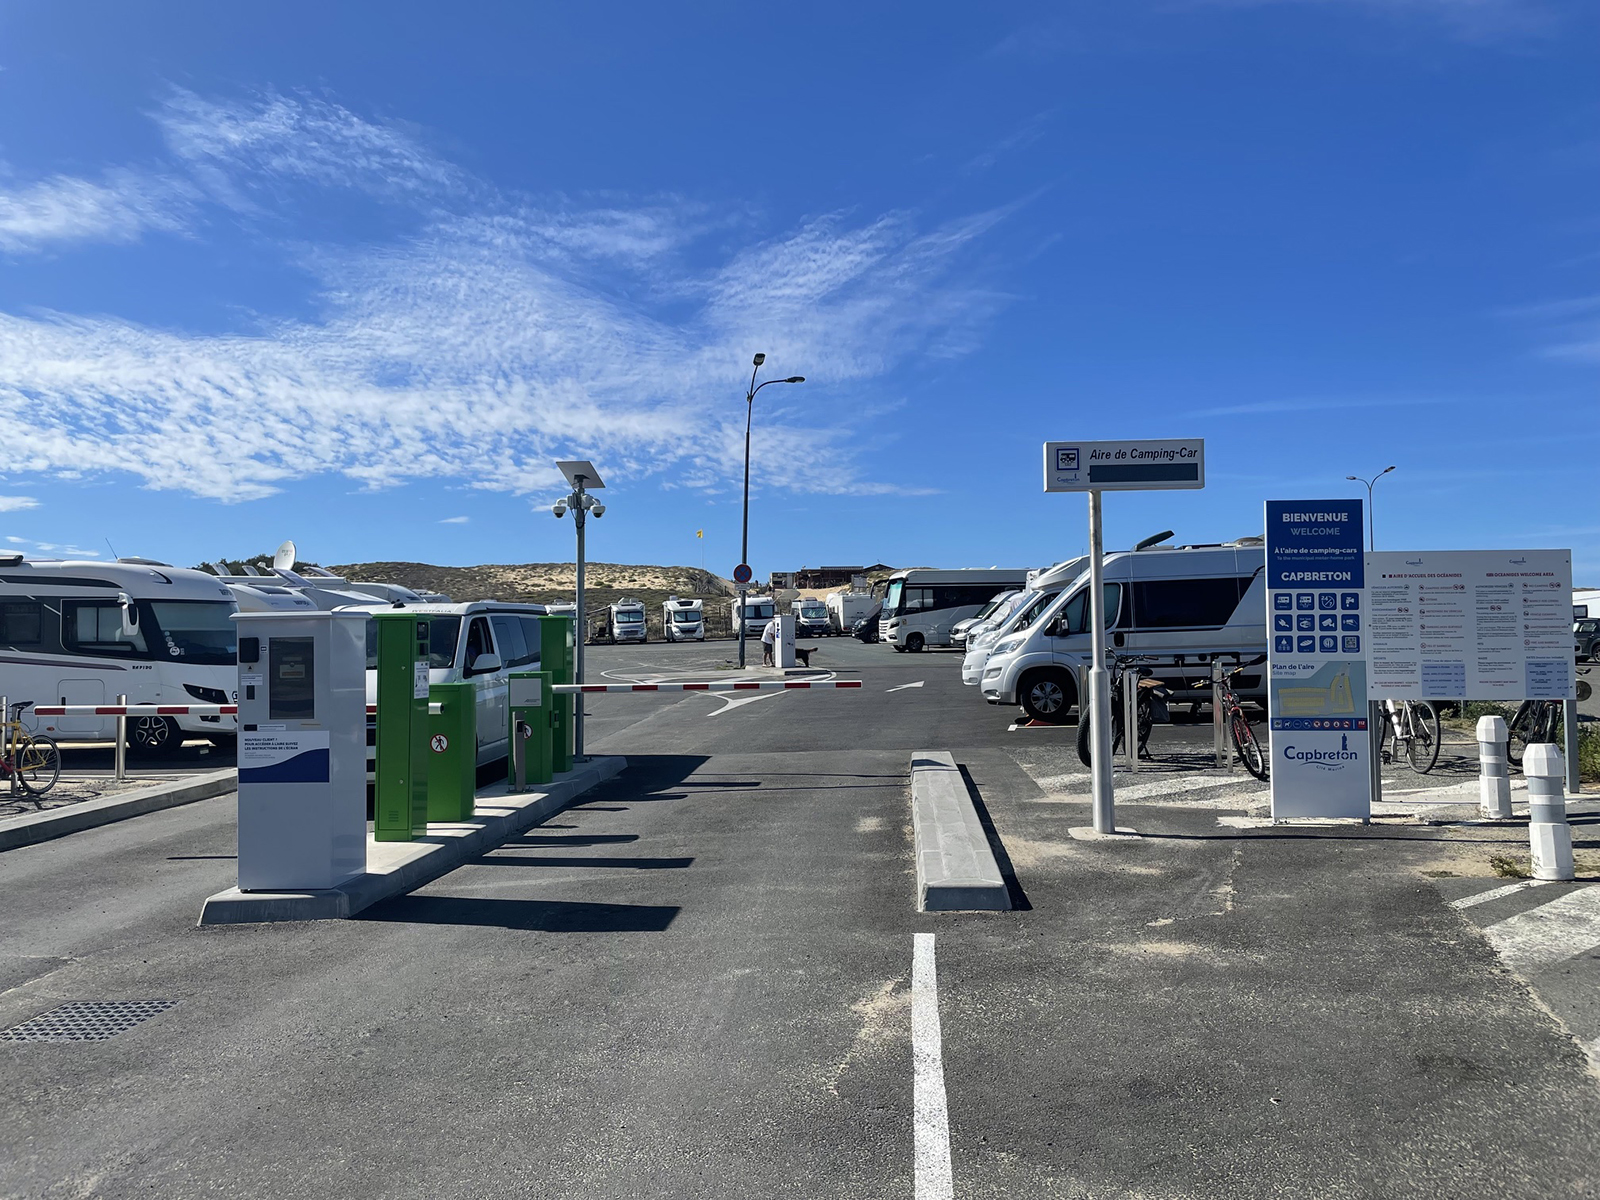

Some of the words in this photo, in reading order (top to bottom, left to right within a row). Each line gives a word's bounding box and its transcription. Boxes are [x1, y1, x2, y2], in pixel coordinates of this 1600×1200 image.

[1089, 449, 1111, 460] Aire
[1114, 449, 1127, 460] de
[1130, 447, 1198, 461] Camping-Car
[1282, 512, 1349, 522] BIENVENUE
[1290, 527, 1341, 536] WELCOME
[1274, 546, 1280, 554] À
[1309, 547, 1358, 555] camping-cars
[1281, 571, 1351, 581] CAPBRETON
[1283, 745, 1358, 762] Capbreton
